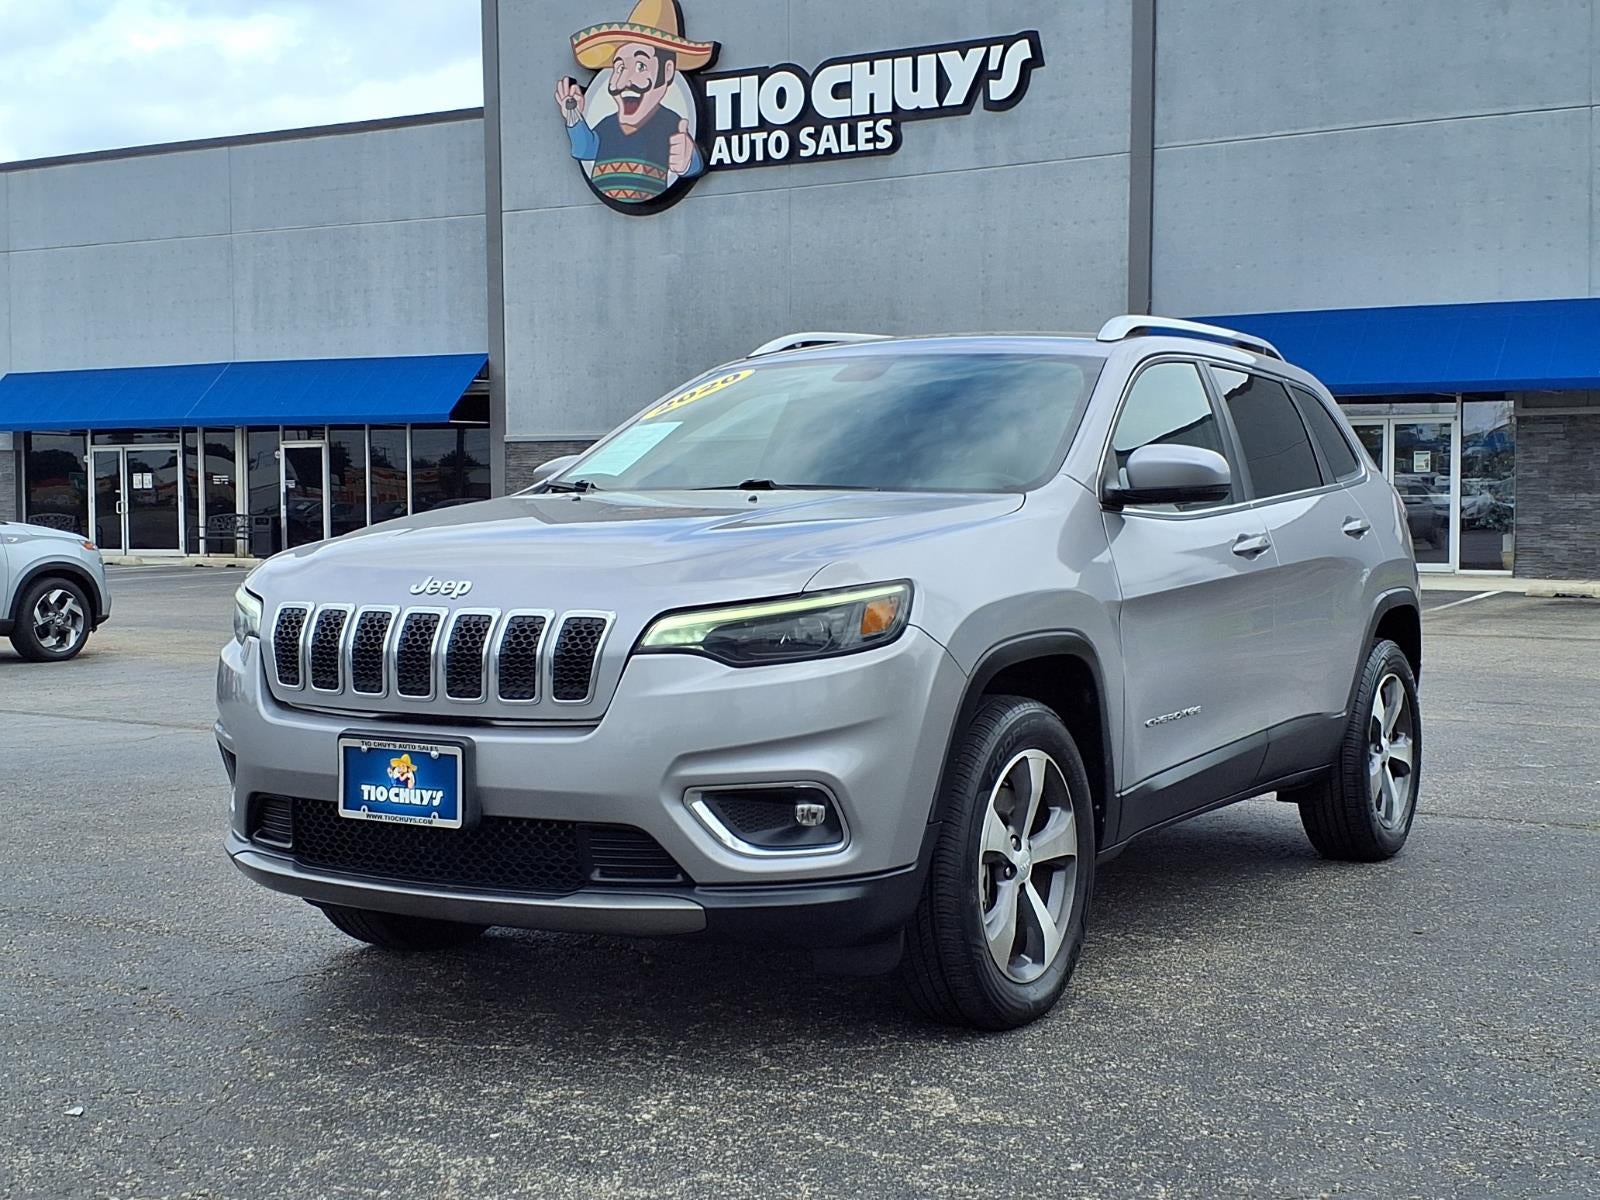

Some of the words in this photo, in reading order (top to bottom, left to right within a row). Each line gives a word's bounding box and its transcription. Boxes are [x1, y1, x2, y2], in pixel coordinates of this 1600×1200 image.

[706, 72, 804, 131] TIO
[811, 39, 1033, 119] CHUY'S
[710, 128, 789, 166] AUTO
[800, 119, 893, 157] SALES
[657, 373, 741, 412] 2020
[409, 575, 473, 600] Jeep
